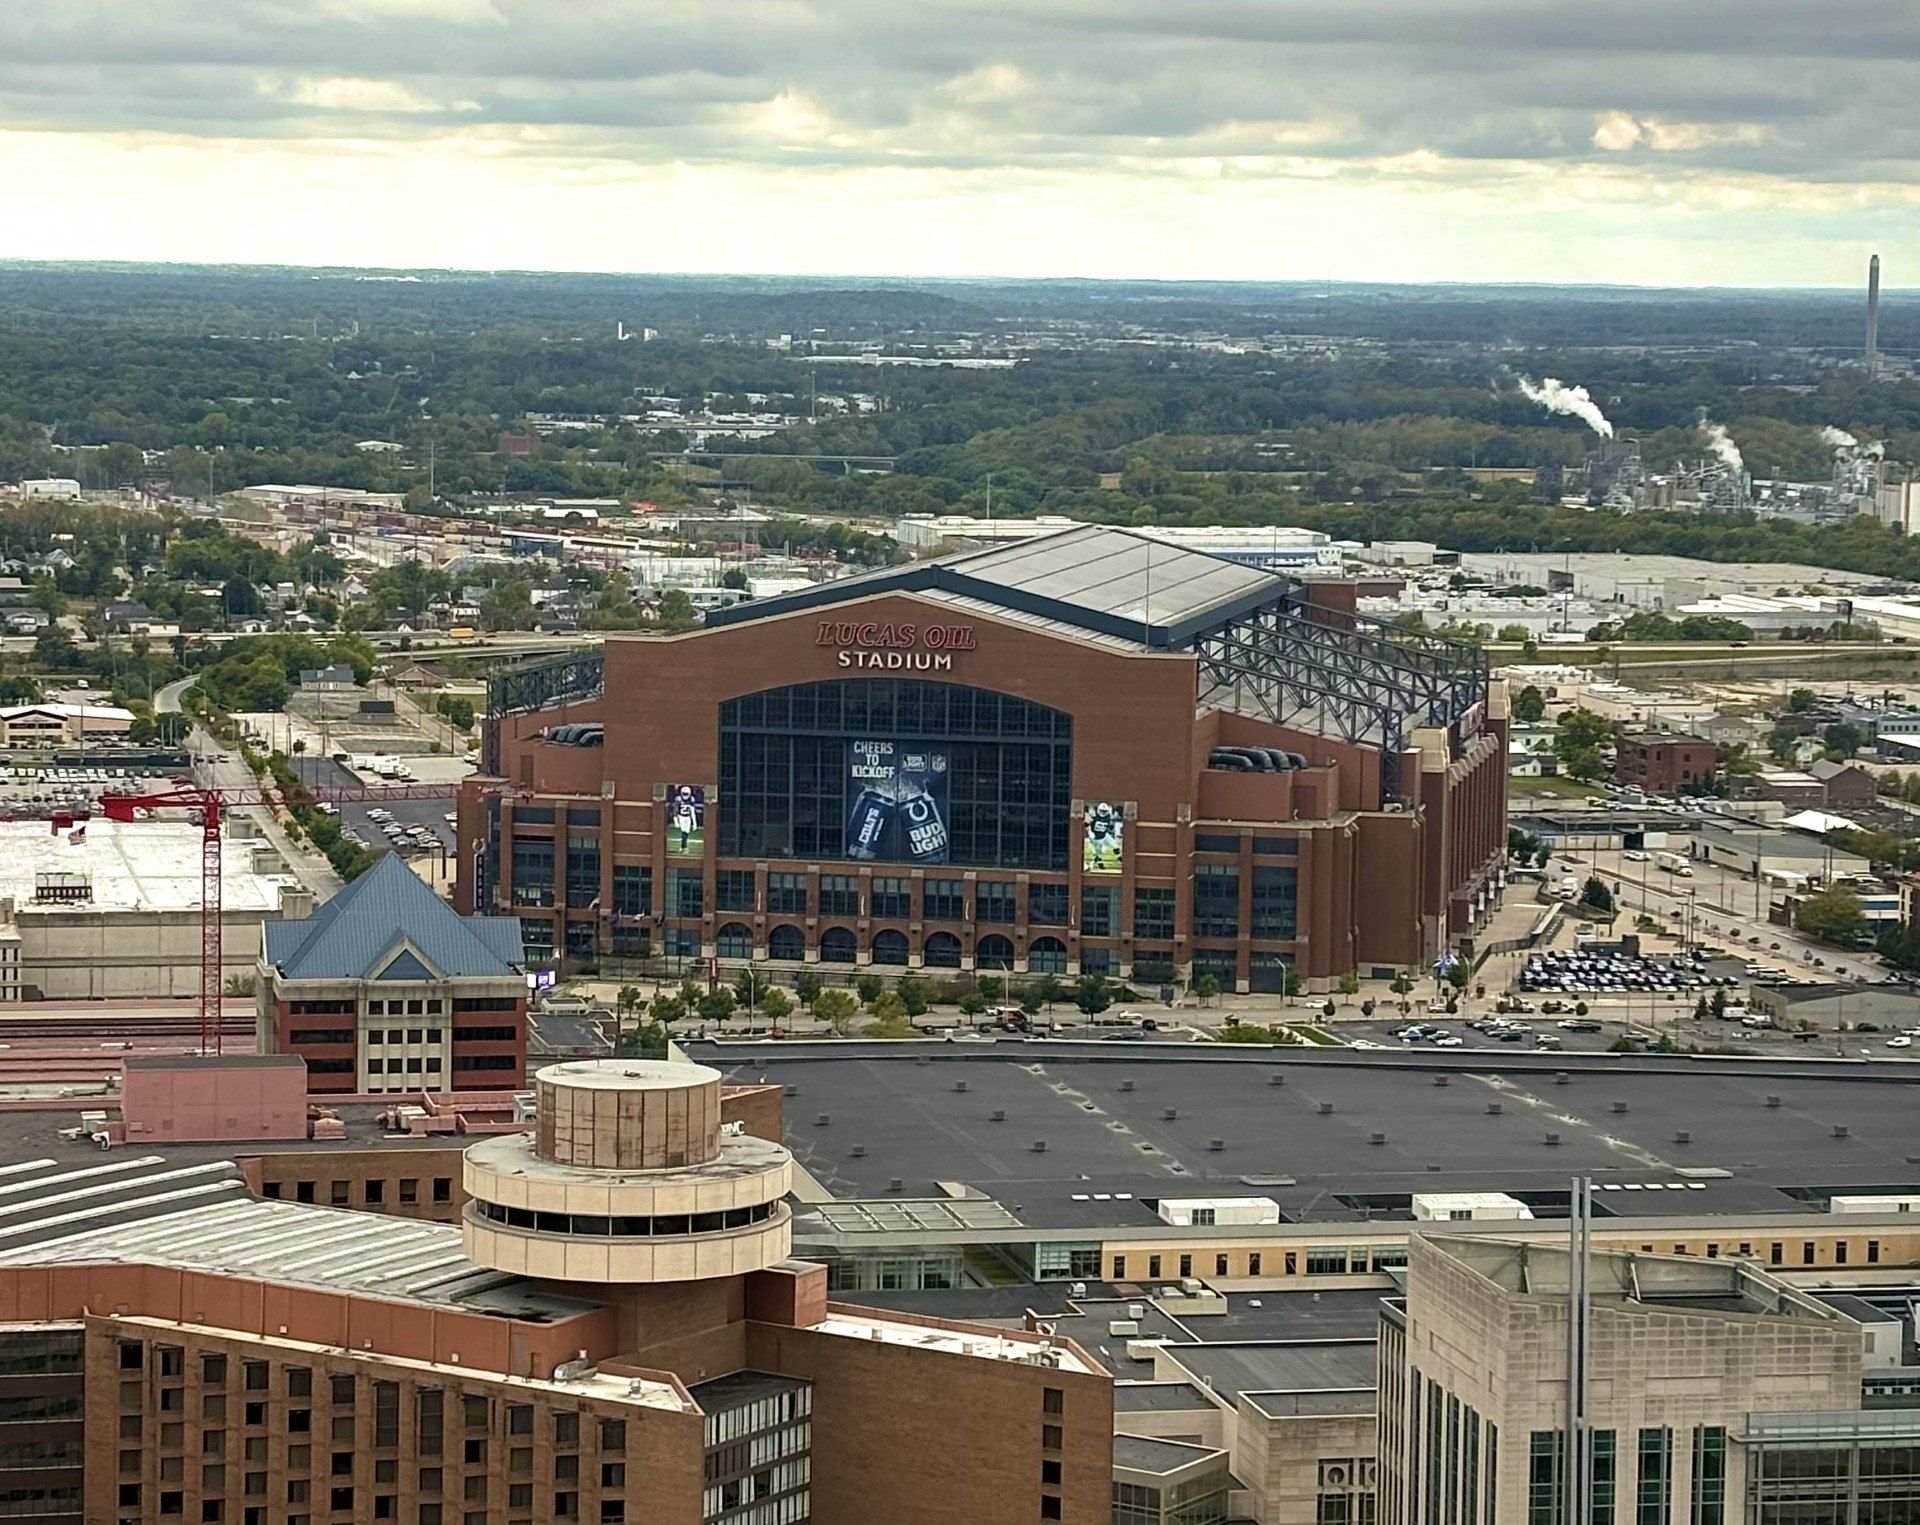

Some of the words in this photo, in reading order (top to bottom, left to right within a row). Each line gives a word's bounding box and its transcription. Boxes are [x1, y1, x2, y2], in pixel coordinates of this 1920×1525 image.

[816, 621, 915, 648] LUCAS
[924, 625, 977, 650] OIL
[838, 650, 951, 670] STADIUM
[853, 741, 894, 754] CHEERS
[865, 754, 879, 765] TO
[852, 765, 895, 778] KICKOFF
[909, 822, 940, 842] BUD
